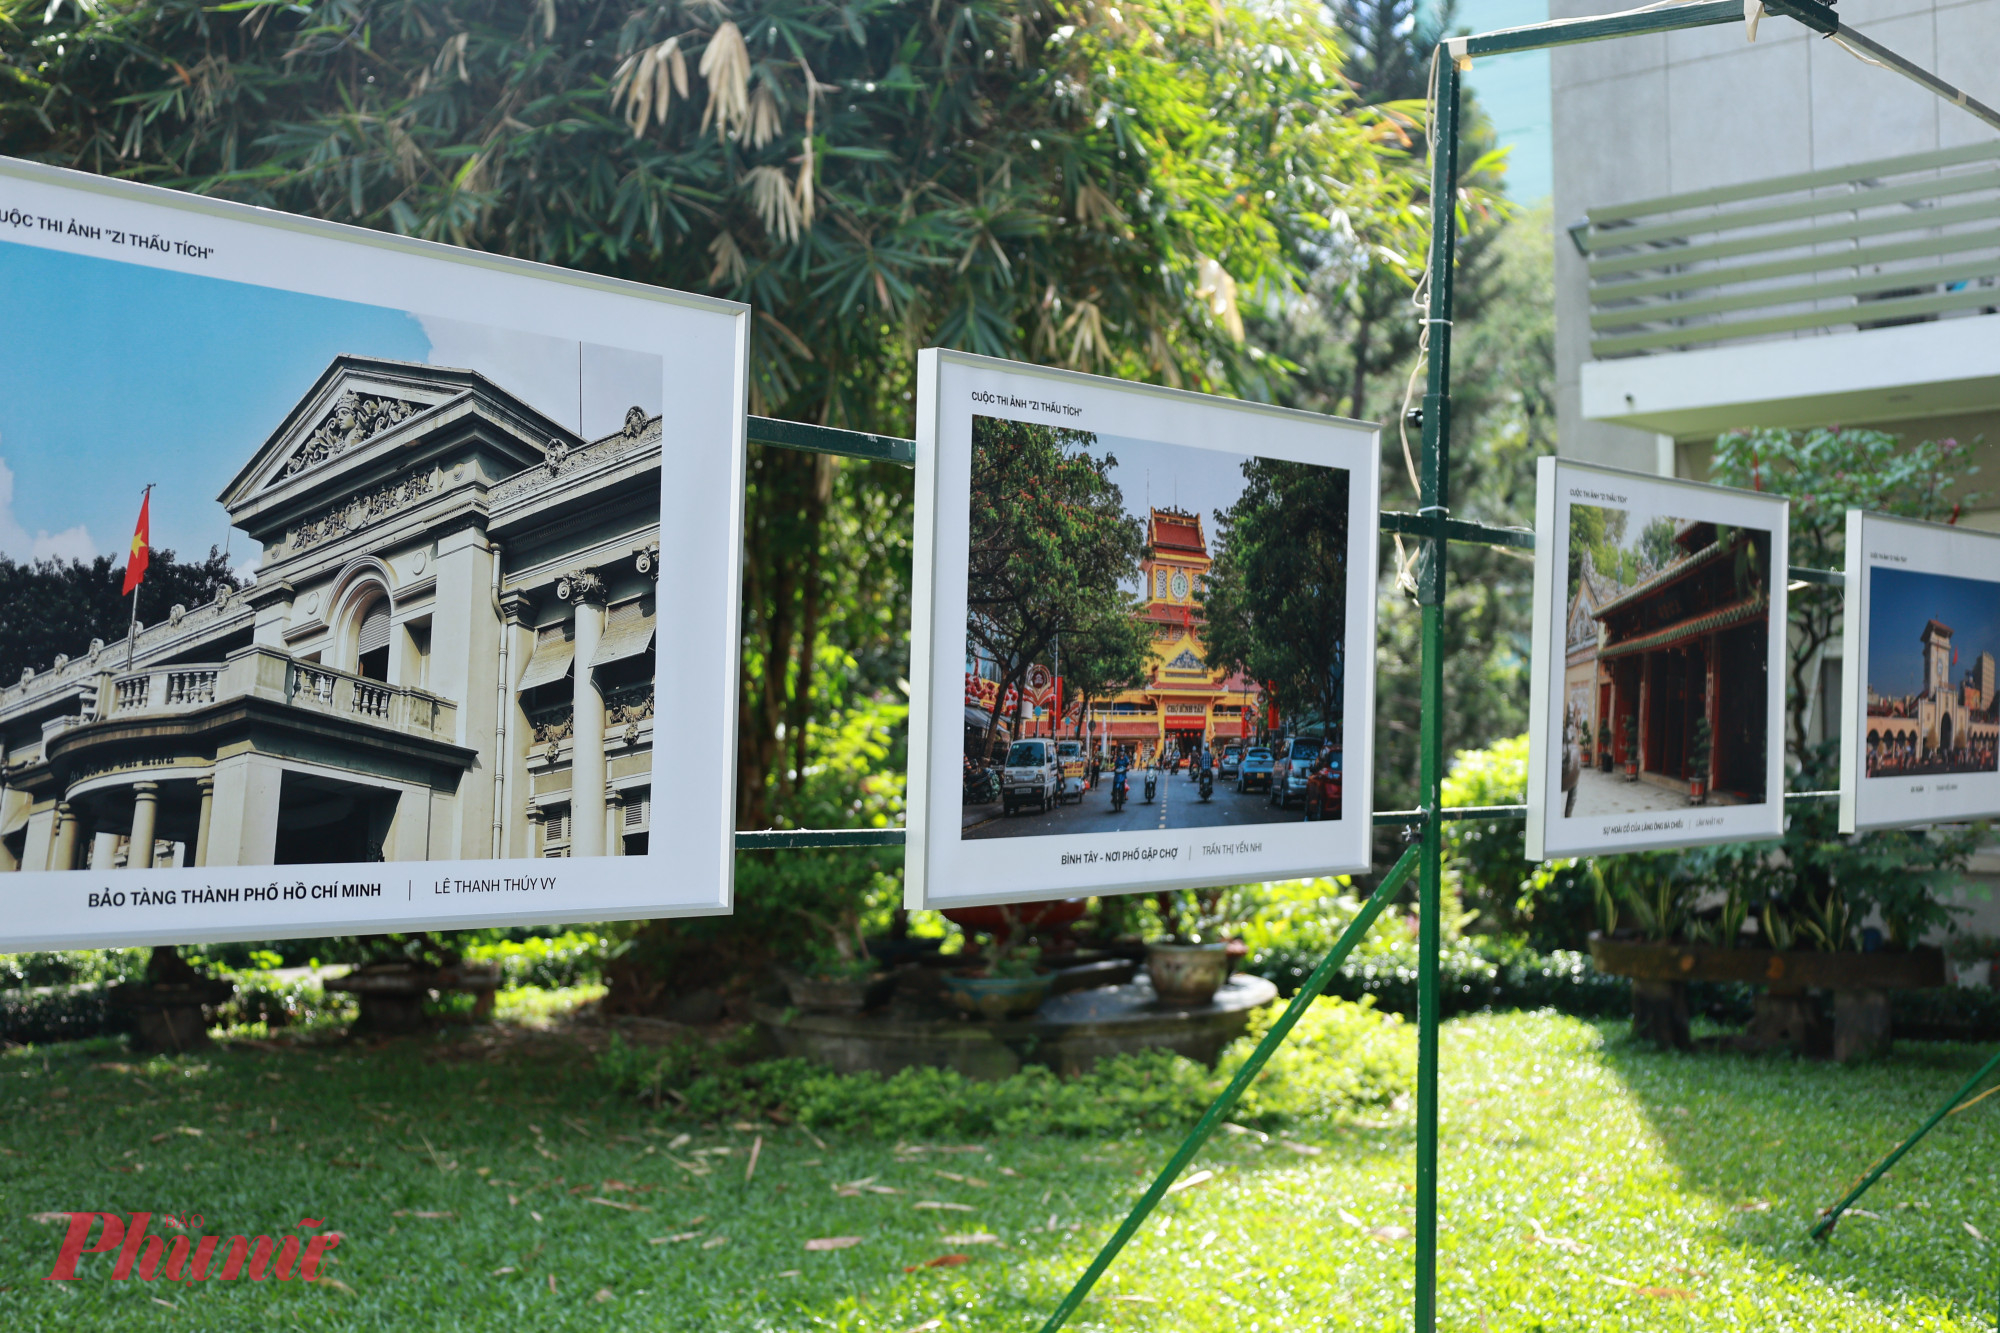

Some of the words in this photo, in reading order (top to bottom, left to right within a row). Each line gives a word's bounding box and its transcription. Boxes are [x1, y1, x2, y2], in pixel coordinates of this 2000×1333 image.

[0, 208, 33, 228] UỘC
[37, 216, 63, 233] THI
[67, 218, 101, 240] ẢNH
[129, 234, 170, 252] THẤU
[174, 241, 214, 259] TÍCH"
[971, 390, 995, 405] CUỘC
[996, 395, 1009, 406] THI
[1010, 395, 1027, 408] ẢNH
[1041, 401, 1061, 414] THẤU
[1061, 852, 1082, 865] BÌNH
[1084, 850, 1099, 863] TÂY
[1105, 851, 1120, 862] NƠI
[1122, 847, 1140, 860] PHỐ
[1141, 847, 1158, 861] GẶP
[1159, 847, 1179, 860] CHỢ
[1250, 843, 1262, 853] NHI
[88, 887, 126, 907] BẢO
[130, 887, 176, 906] TÀNG
[181, 885, 239, 904] THÀNH
[244, 881, 279, 901] PHỐ
[283, 881, 308, 900] HỒ
[311, 880, 339, 899] CHÍ
[342, 883, 381, 898] MINH
[434, 877, 451, 894] LÊ
[454, 879, 500, 893] THANH
[504, 874, 538, 891] THÚY
[540, 877, 557, 890] VY
